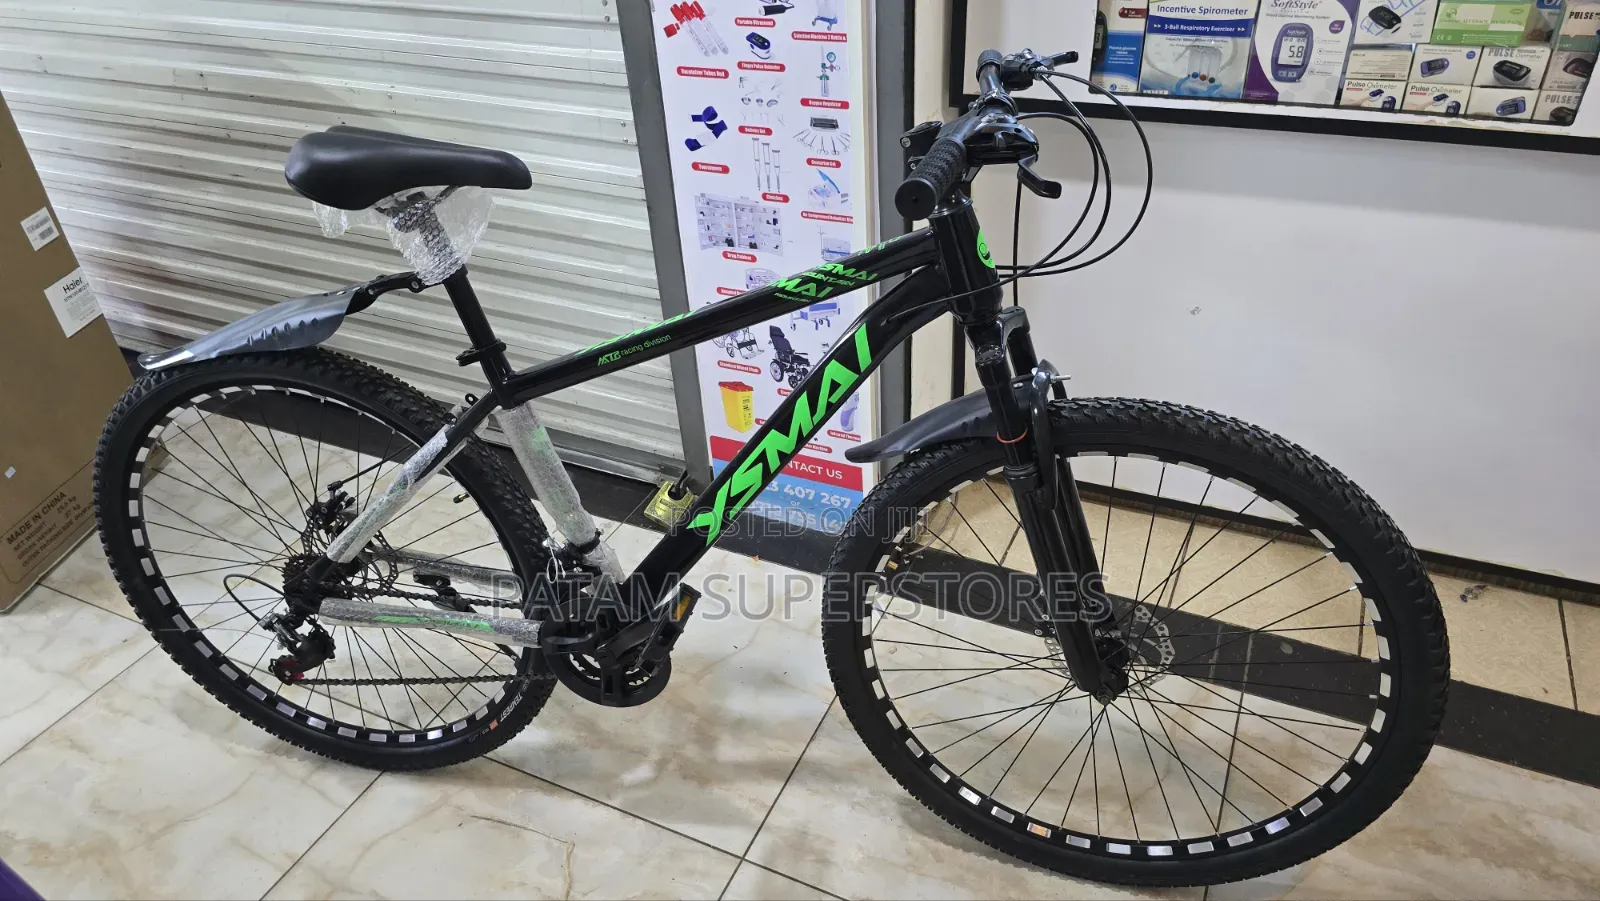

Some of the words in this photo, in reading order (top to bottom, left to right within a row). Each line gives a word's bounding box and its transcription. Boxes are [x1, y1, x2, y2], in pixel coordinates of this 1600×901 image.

[1157, 5, 1196, 14] Incentive
[1198, 6, 1248, 15] Spirometer
[1569, 11, 1594, 20] PULSE
[1488, 48, 1514, 57] PULSE
[1366, 81, 1397, 90] Oximeter
[1430, 86, 1462, 94] Oximeter
[1545, 94, 1573, 104] PULSE
[62, 276, 83, 294] Haier
[620, 344, 643, 356] racing
[643, 334, 672, 349] division
[786, 460, 823, 475] NTACT
[826, 468, 843, 480] US
[784, 484, 815, 500] 407
[820, 492, 852, 509] 267
[6, 523, 33, 545] MADE
[32, 512, 42, 524] IN
[42, 492, 67, 515] CHINA
[500, 692, 523, 722] TEMPEST
